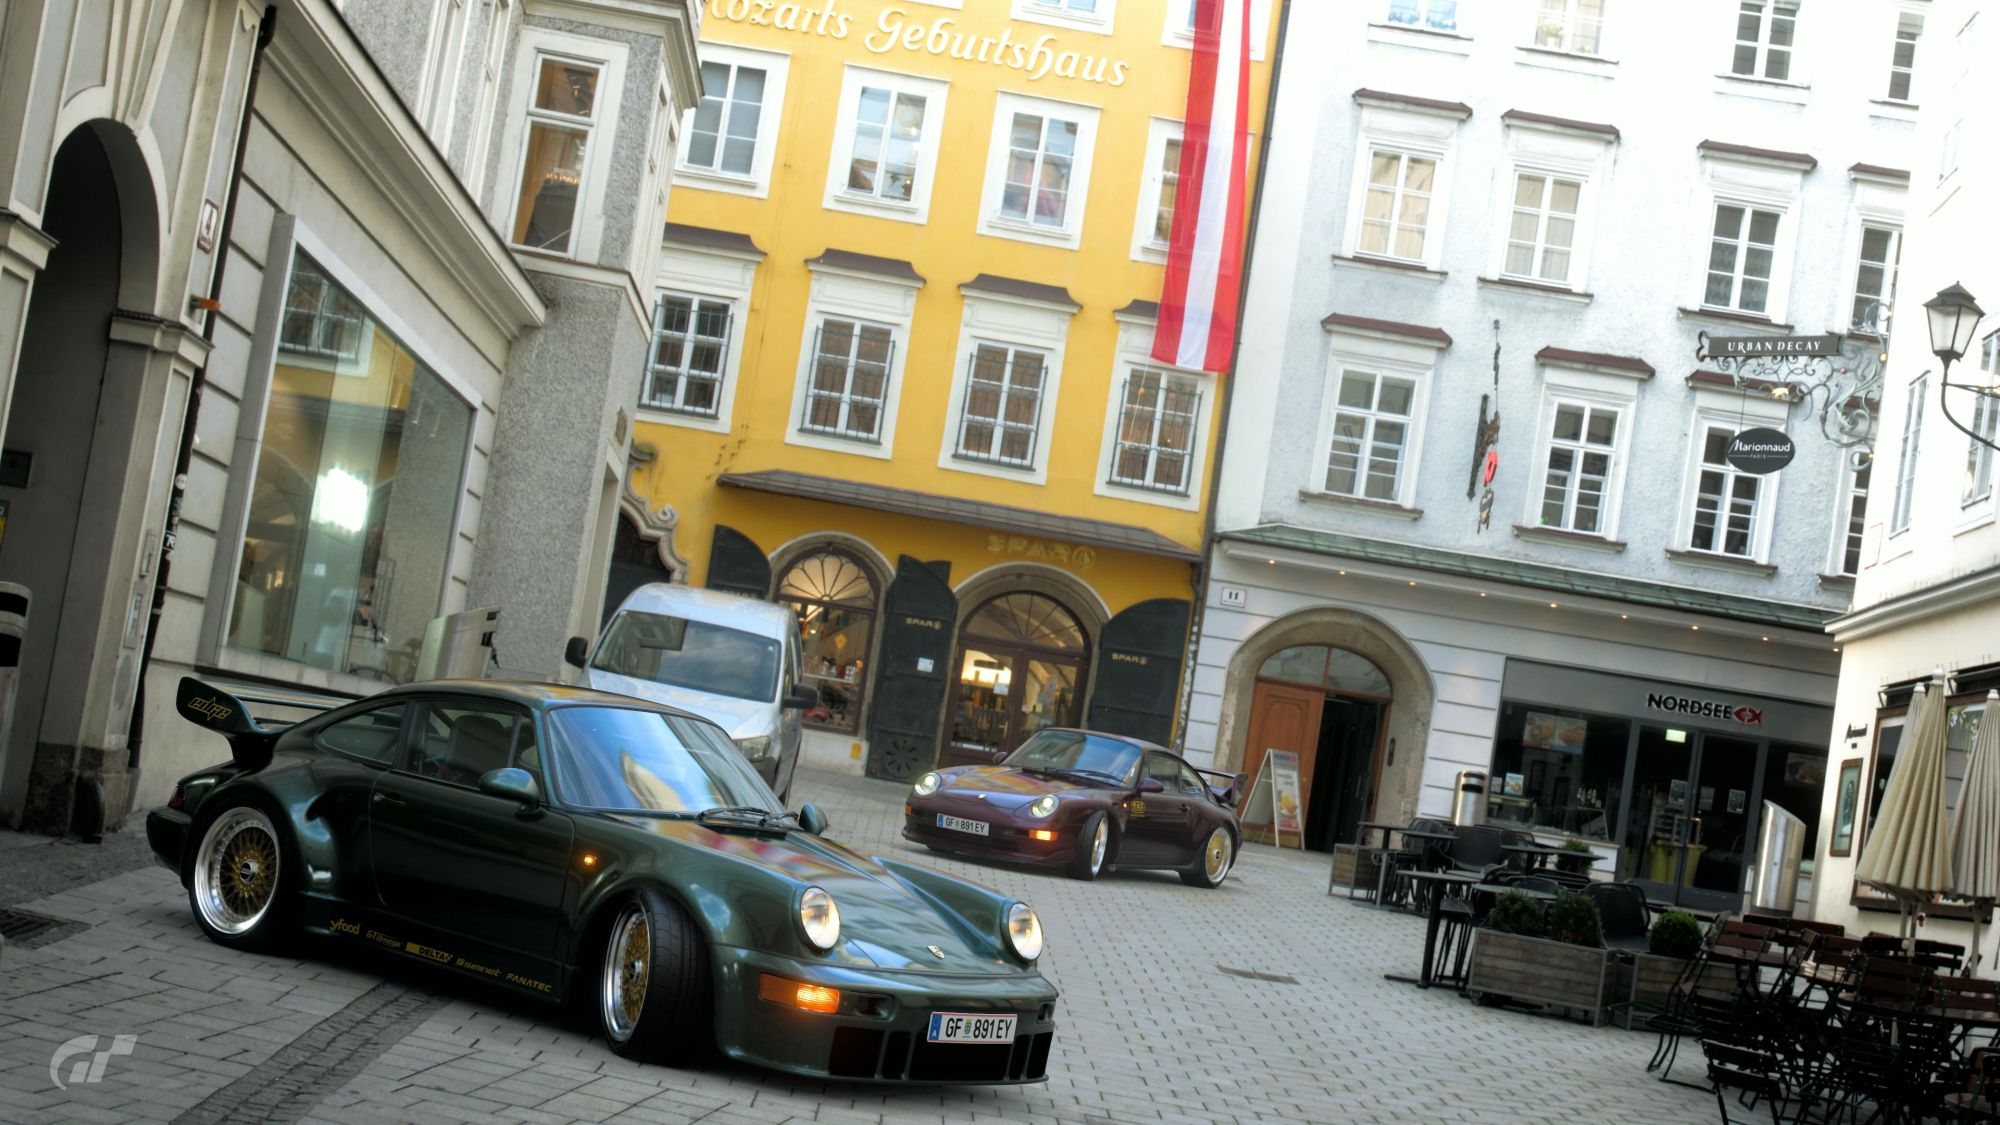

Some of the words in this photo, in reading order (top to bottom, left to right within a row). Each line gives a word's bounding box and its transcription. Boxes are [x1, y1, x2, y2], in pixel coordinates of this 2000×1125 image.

[864, 7, 1130, 87] Geburtshaus
[205, 207, 214, 236] 4
[1727, 341, 1773, 354] URBAN
[1777, 340, 1821, 352] DECAY
[1728, 439, 1791, 454] Marionnaud
[986, 534, 1070, 563] SPAR
[1228, 591, 1239, 601] 11
[905, 617, 934, 629] SPAR
[1112, 652, 1139, 663] SPAR
[1647, 693, 1732, 720] NORDSEE
[945, 817, 955, 827] GF
[960, 820, 974, 831] 891
[329, 918, 361, 936] yfood
[505, 972, 553, 993] FANATEC
[945, 1017, 964, 1038] GF
[973, 1018, 995, 1039] 891
